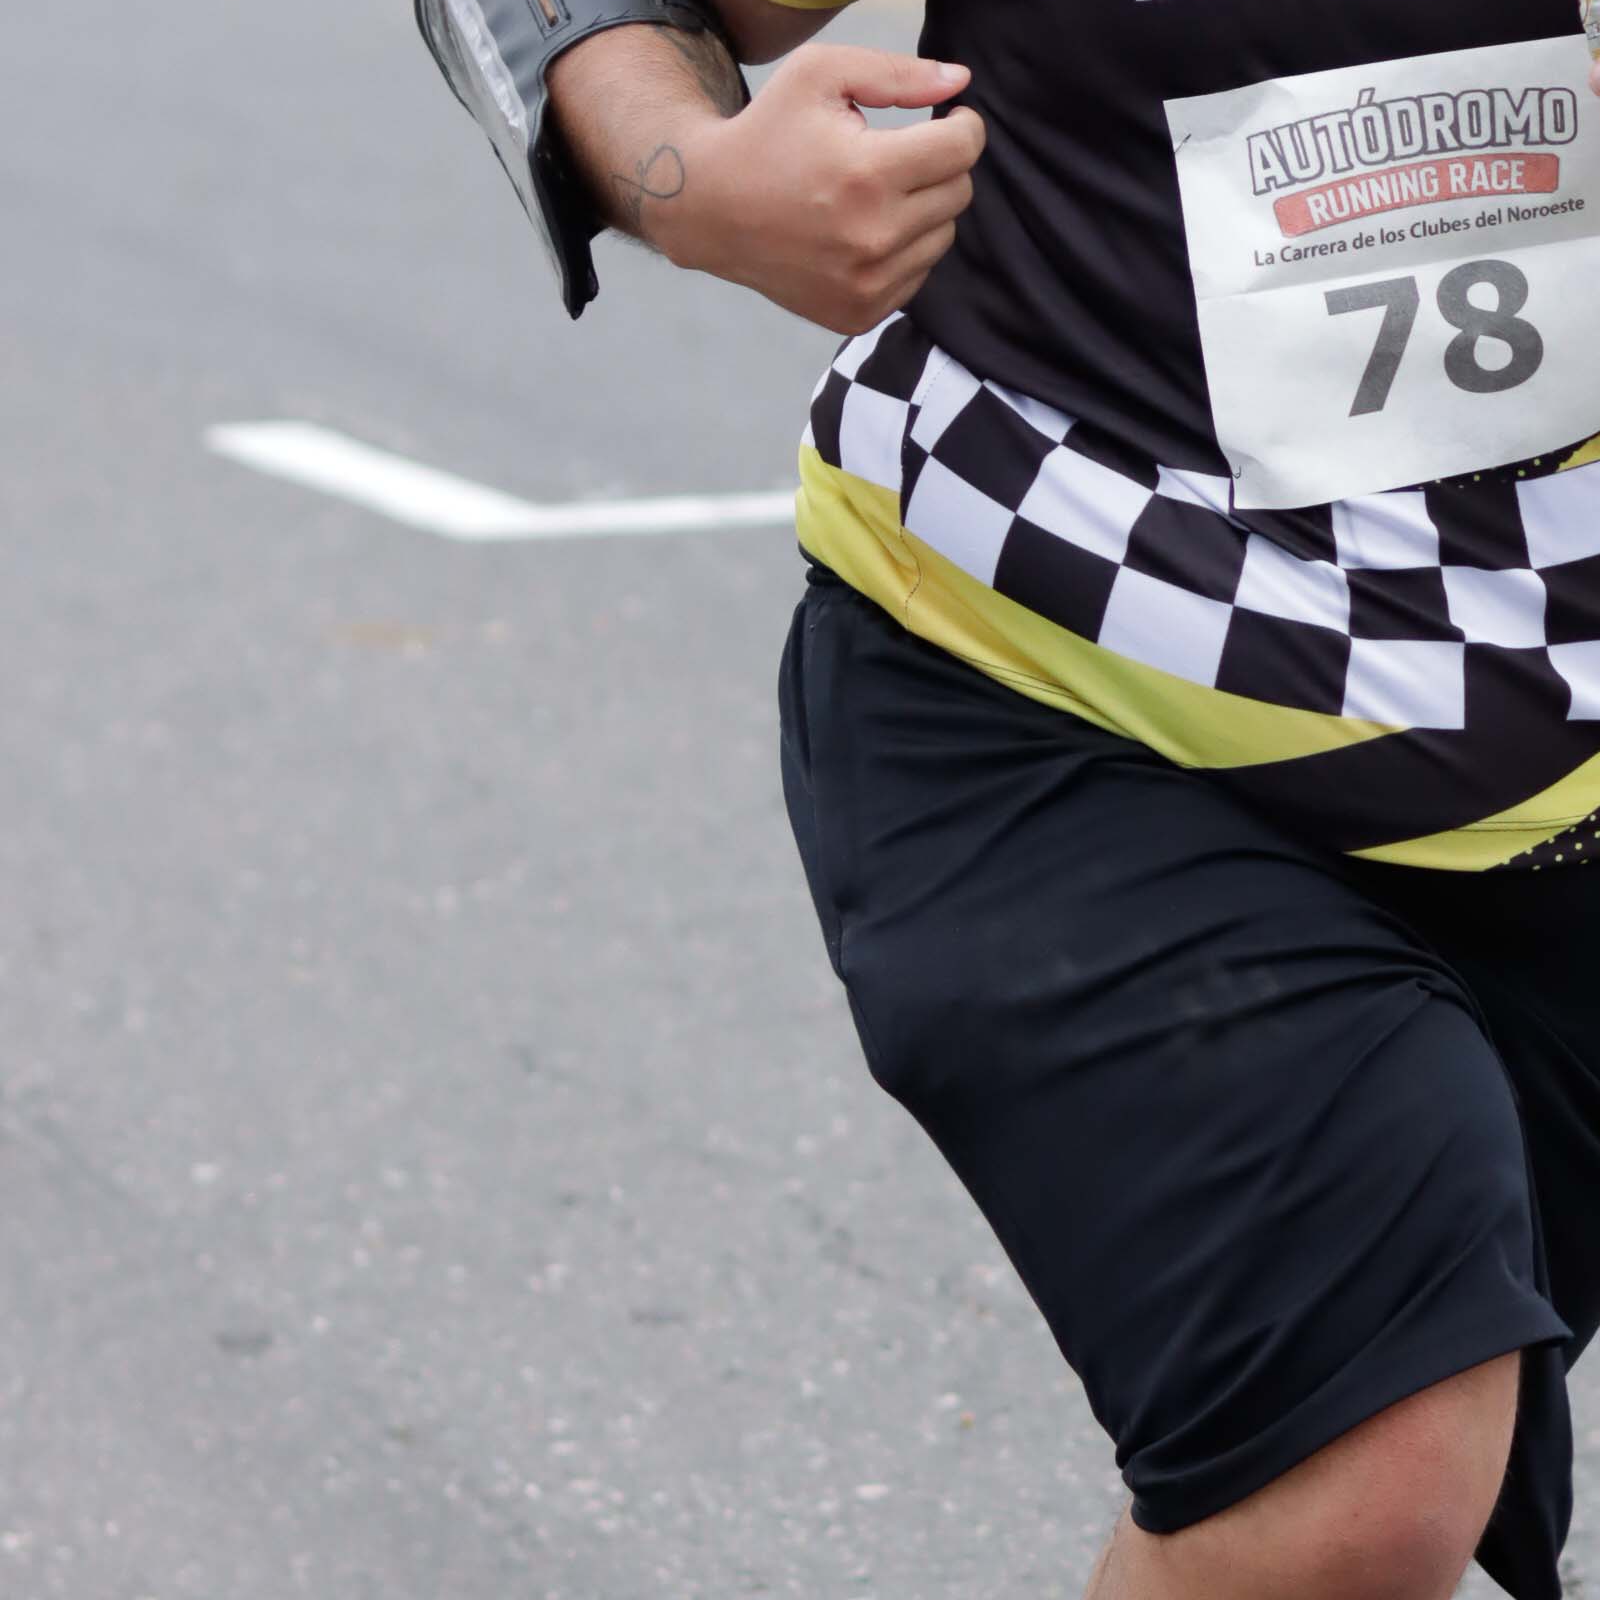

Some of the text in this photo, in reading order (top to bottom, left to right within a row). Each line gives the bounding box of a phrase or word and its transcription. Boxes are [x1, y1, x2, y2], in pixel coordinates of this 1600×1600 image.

[1246, 87, 1578, 196] AUTÓDROMO
[1254, 197, 1586, 267] La Carrera de los Clubes del Noroeste
[1305, 159, 1526, 226] RUNNING RACE
[1324, 259, 1545, 418] 78
